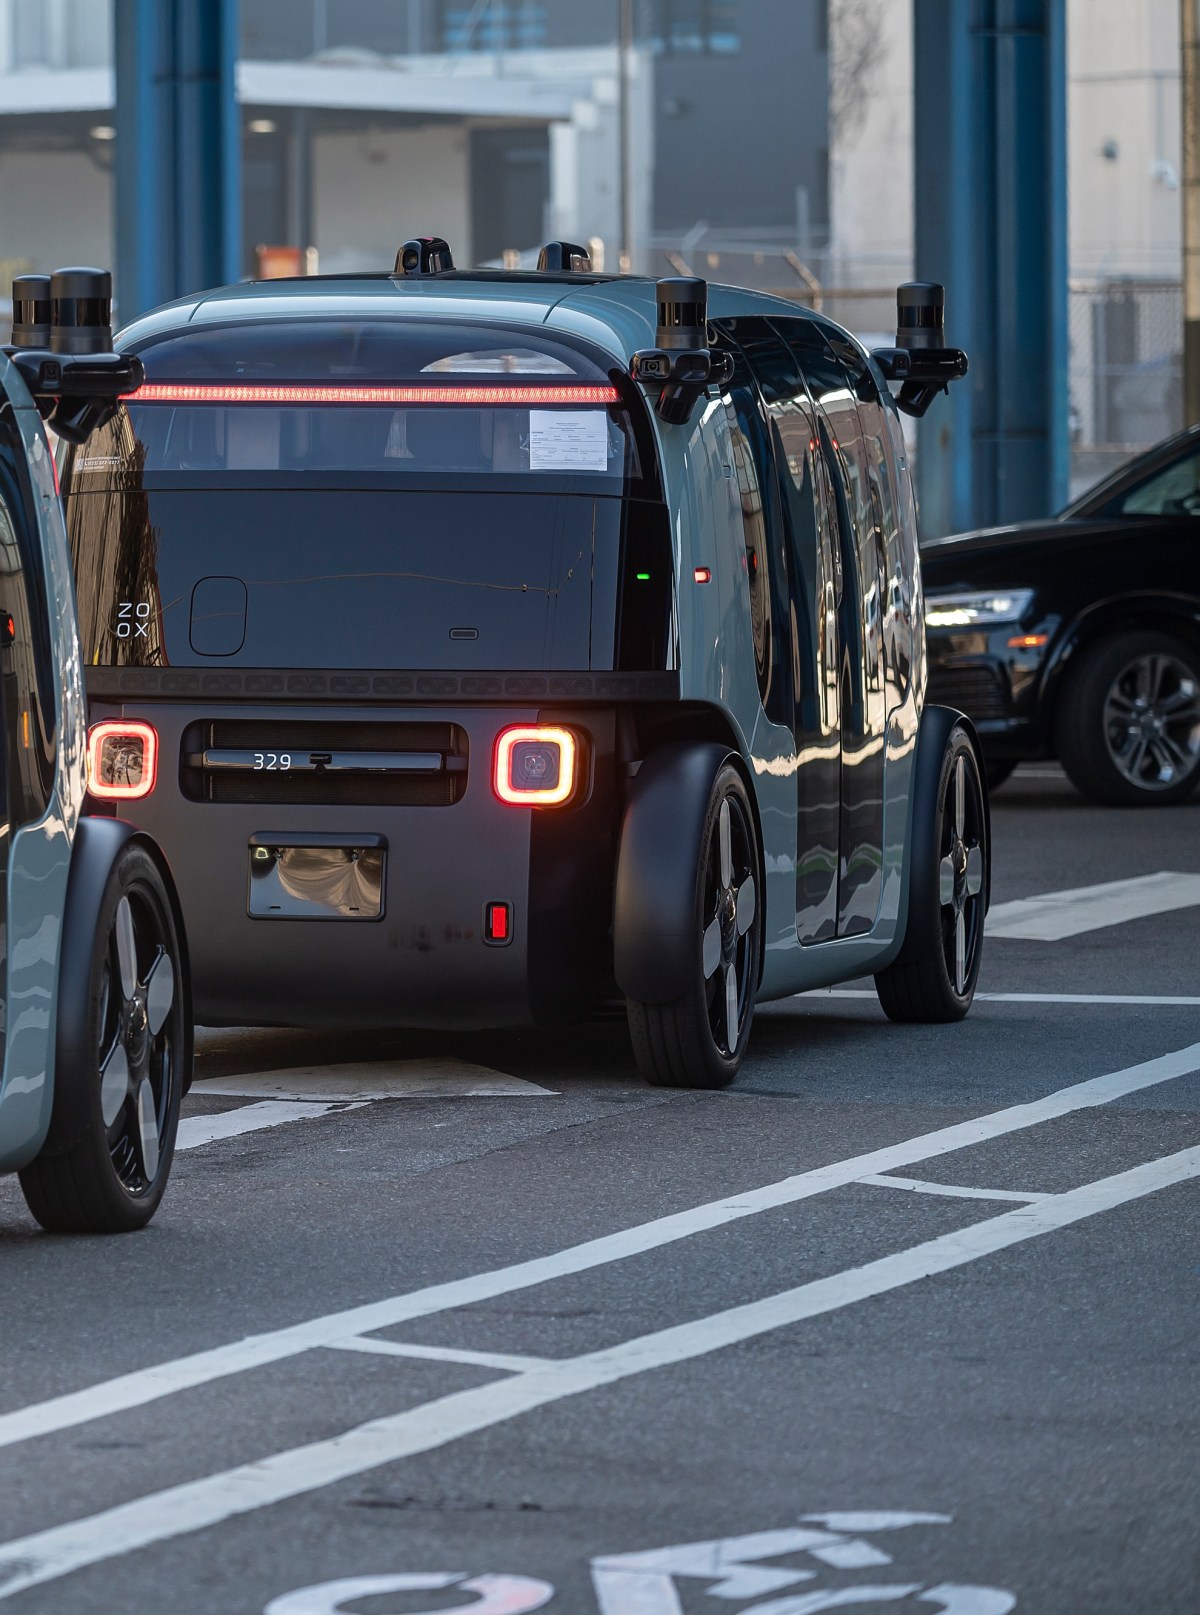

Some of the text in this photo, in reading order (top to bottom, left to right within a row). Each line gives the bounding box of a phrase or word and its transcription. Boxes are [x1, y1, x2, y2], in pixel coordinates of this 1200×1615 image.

[118, 602, 150, 618] ZO
[117, 622, 149, 638] OX
[253, 753, 291, 770] 329
